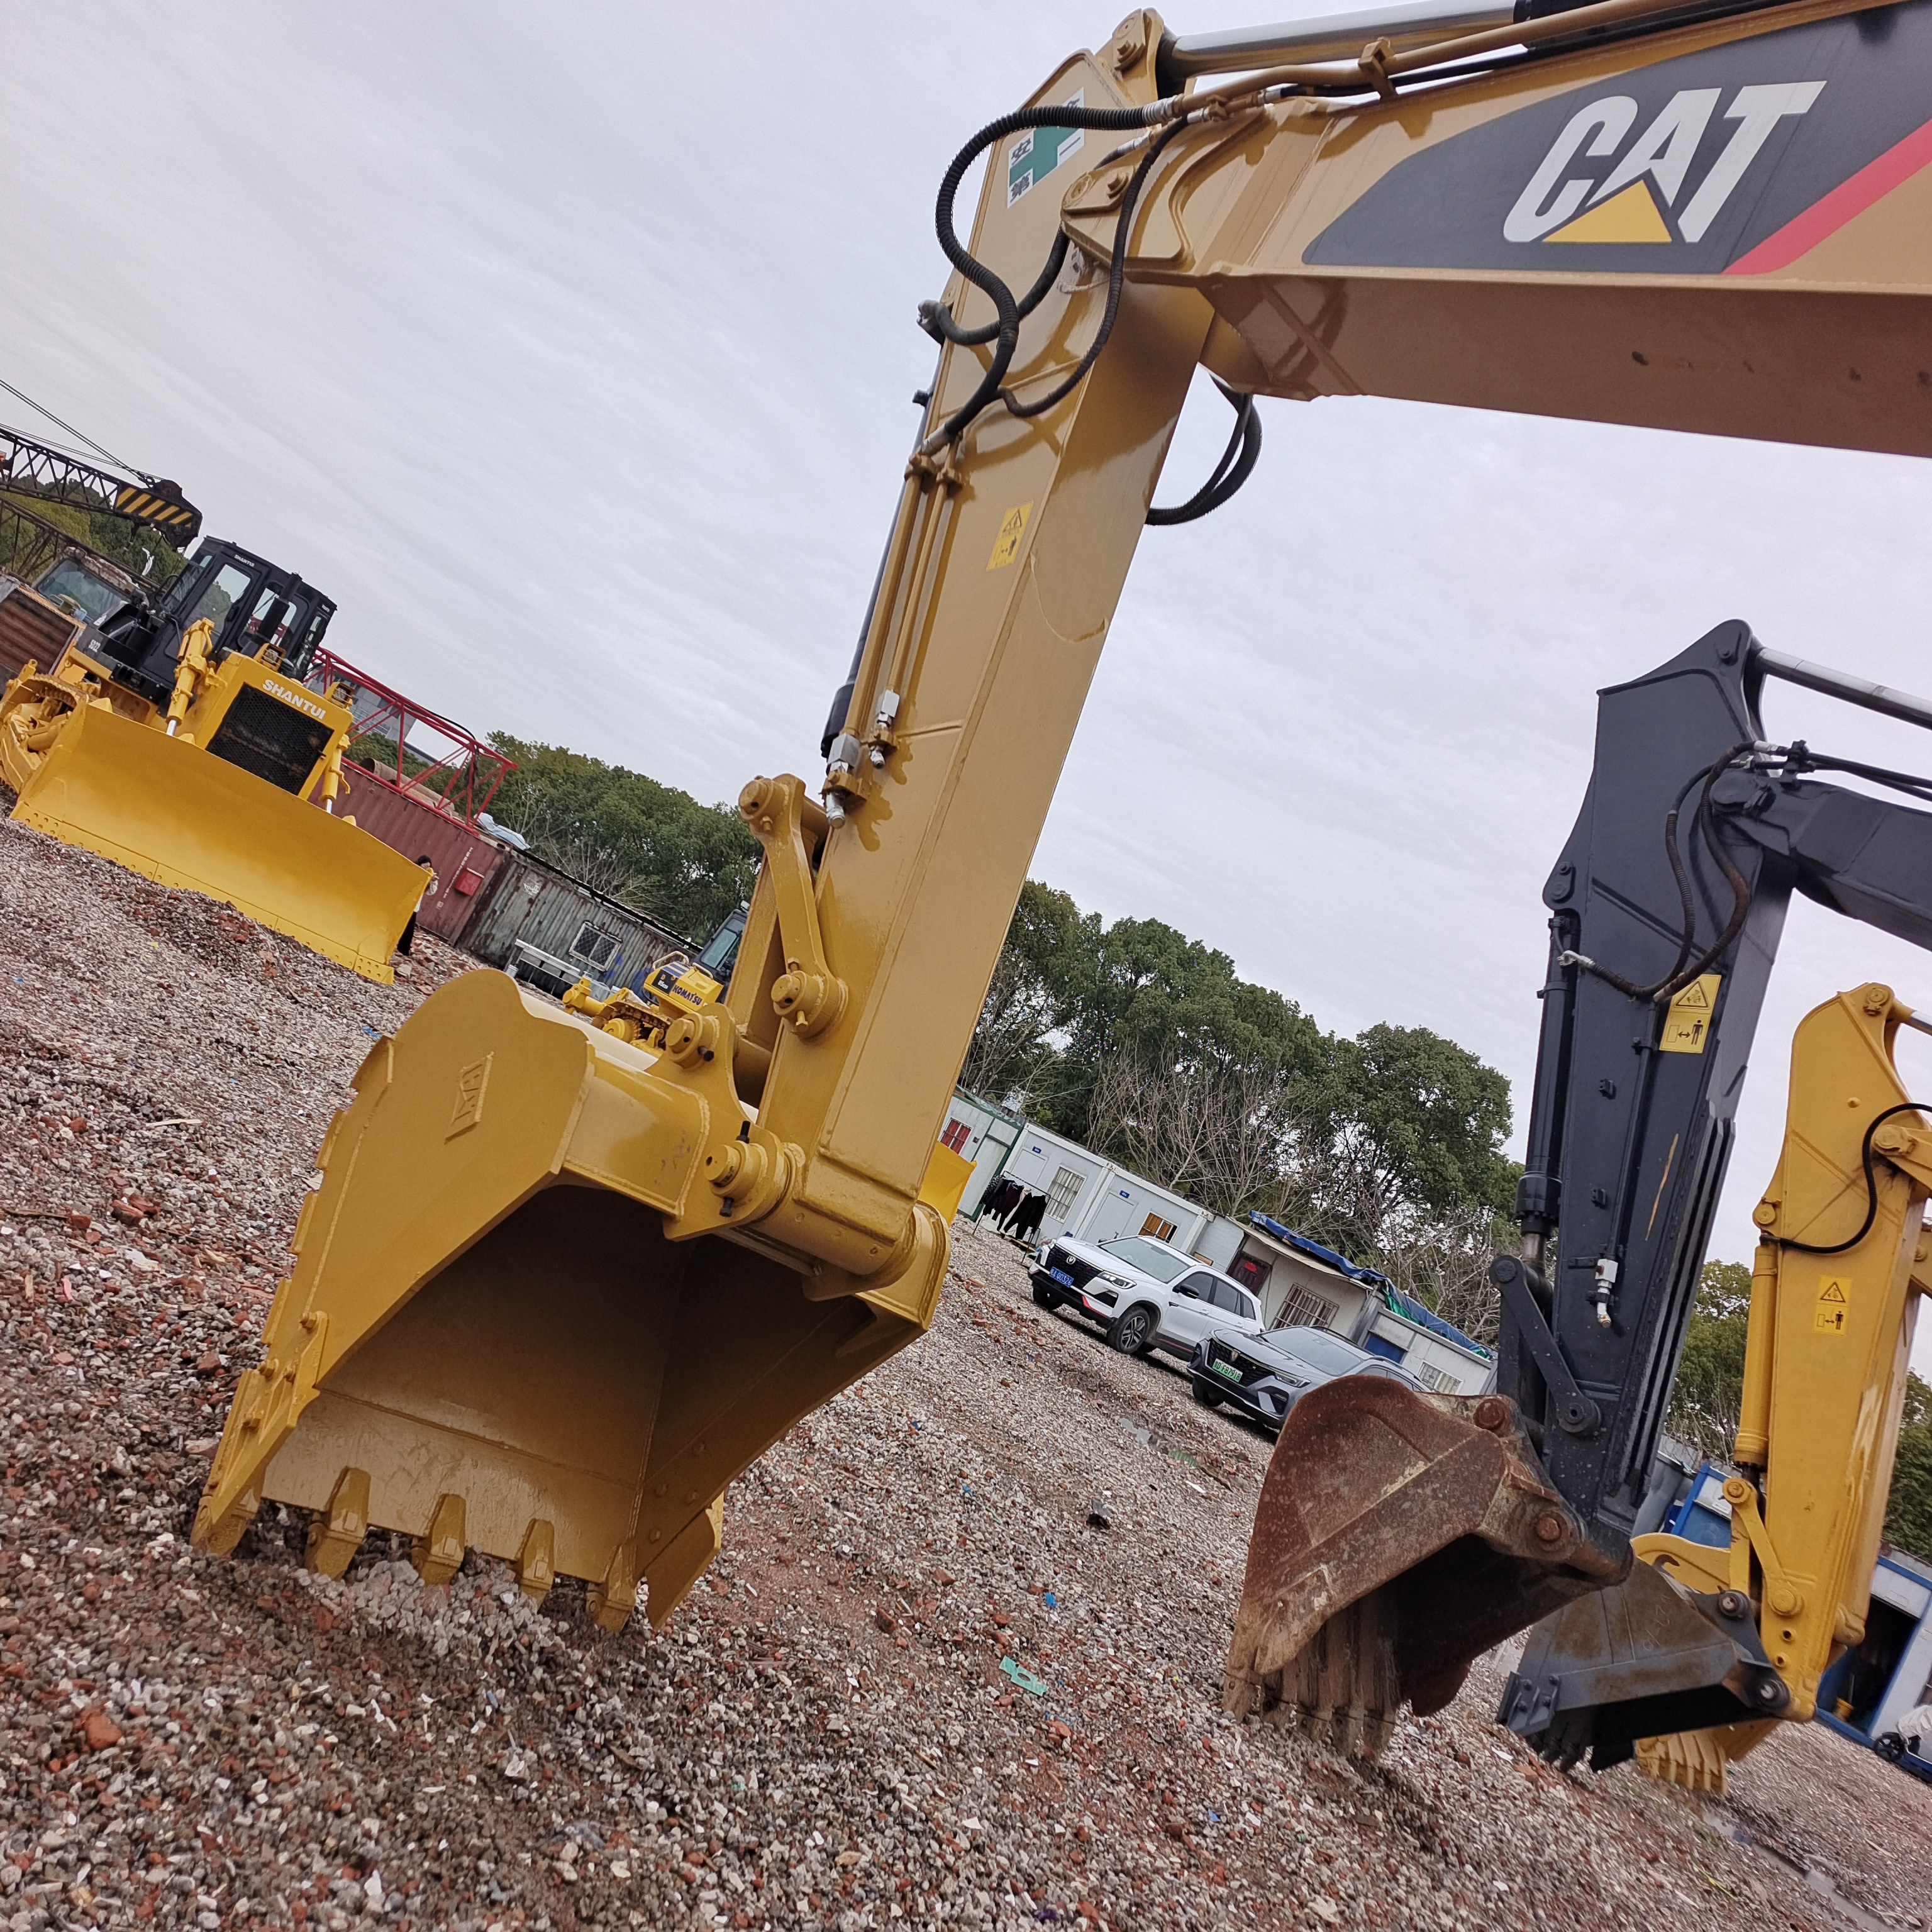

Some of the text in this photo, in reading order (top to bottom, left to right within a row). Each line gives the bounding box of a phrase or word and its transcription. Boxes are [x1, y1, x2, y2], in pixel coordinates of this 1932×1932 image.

[1503, 80, 1827, 243] CAT
[262, 679, 326, 719] SHANTUI
[672, 985, 702, 1006] KOMATSU
